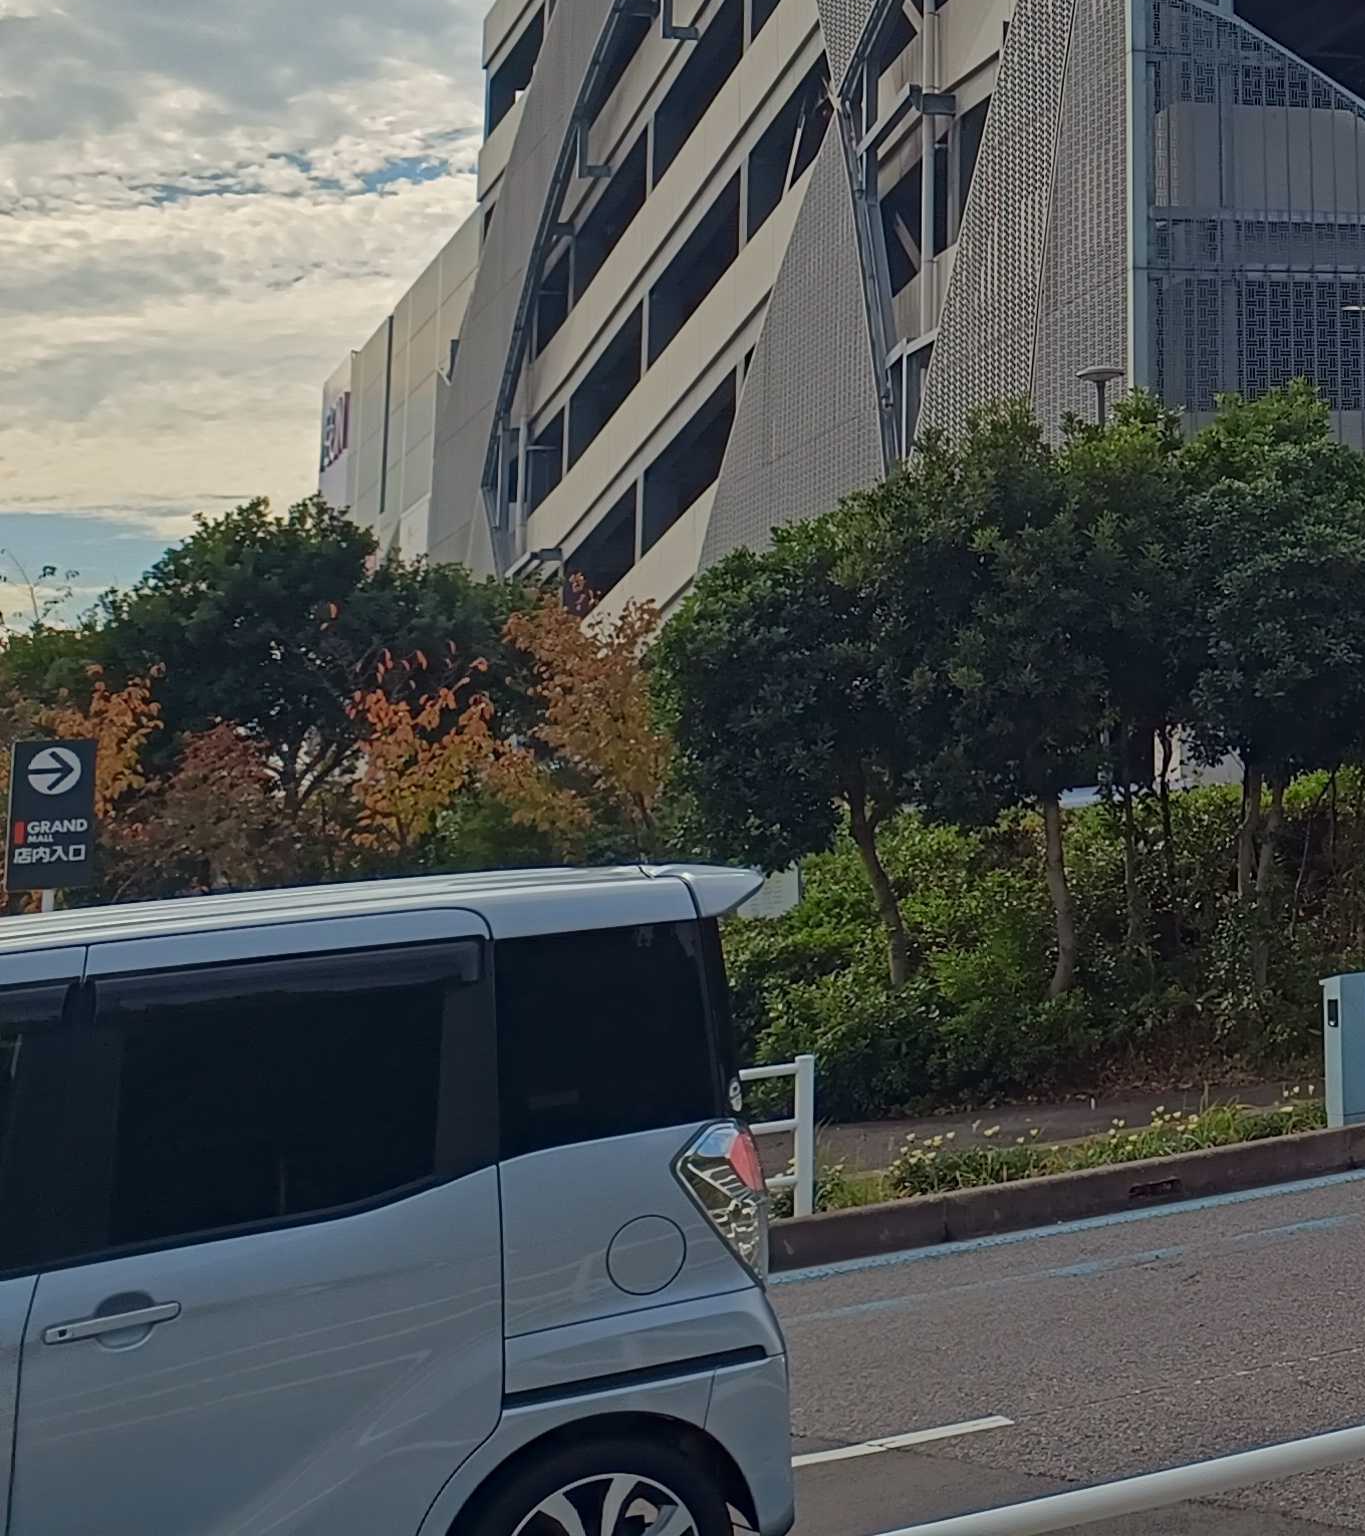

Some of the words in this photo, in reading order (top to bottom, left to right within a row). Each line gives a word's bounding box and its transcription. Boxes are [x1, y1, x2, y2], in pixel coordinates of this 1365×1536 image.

[27, 819, 88, 834] GRAND
[27, 834, 53, 844] MALL
[13, 844, 86, 864] 店内入口
